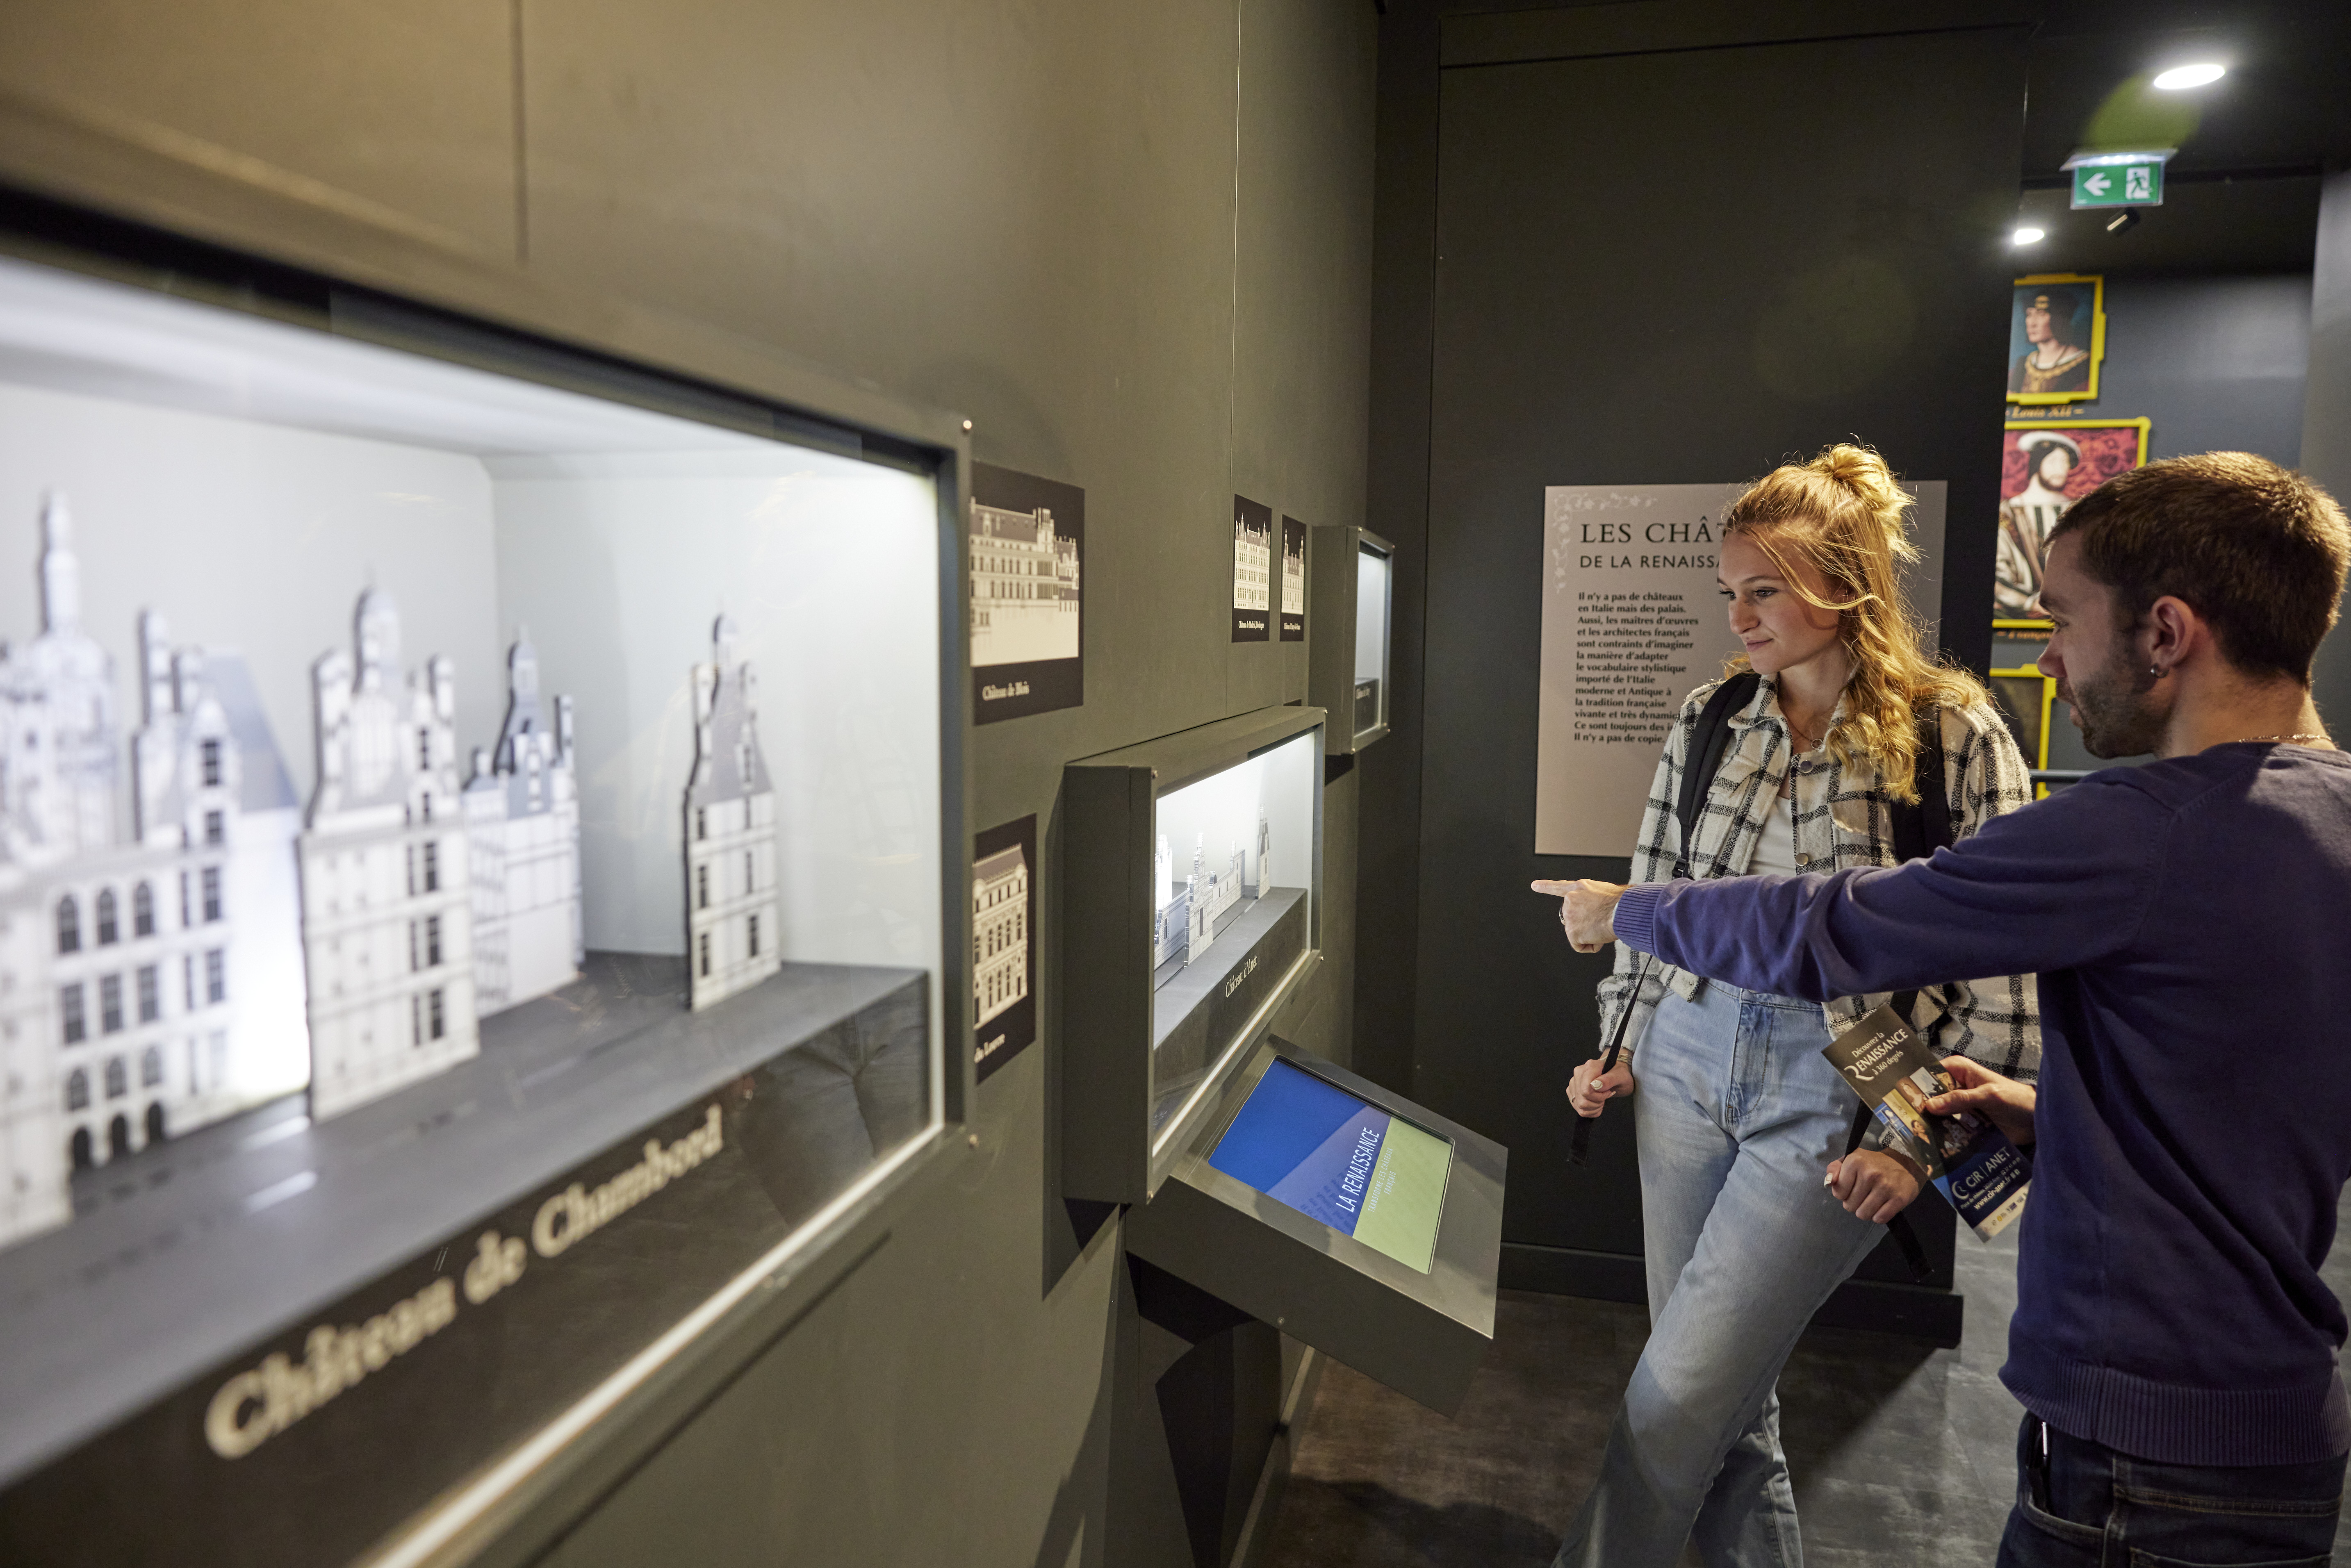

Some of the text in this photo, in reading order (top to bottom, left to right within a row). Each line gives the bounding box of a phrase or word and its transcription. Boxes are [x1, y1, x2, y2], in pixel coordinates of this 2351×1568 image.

[1581, 523, 1631, 543] LES
[1580, 555, 1720, 568] DE LA RENAISS
[1579, 592, 1585, 600] Il
[1612, 593, 1626, 603] pas
[1629, 592, 1639, 601] de
[1643, 592, 1683, 601] châteaux
[1592, 604, 1614, 612] Italie
[1617, 604, 1637, 612] mais
[1640, 604, 1654, 612] des
[1658, 604, 1686, 614] palais.
[1578, 616, 1603, 624] Aussi,
[1606, 616, 1617, 624] les
[1589, 628, 1600, 636] les
[1654, 628, 1690, 638] français
[1576, 651, 1584, 660] la
[1587, 651, 1623, 660] manière
[1576, 662, 1584, 671] le
[1641, 664, 1686, 674] stylistique
[1576, 674, 1611, 684] importé
[1613, 675, 1624, 683] de
[1628, 687, 1663, 697] Antique
[1666, 687, 1671, 696] à
[1575, 697, 1666, 708] la tradition française
[1575, 709, 1606, 717] vivante
[1611, 722, 1646, 732] toujours
[1607, 735, 1621, 744] pas
[1226, 972, 1243, 998] Château
[1852, 1036, 1879, 1058] Découvrez
[1844, 1029, 1908, 1081] RENAISSANCE
[1876, 1062, 1888, 1072] 360
[1886, 1051, 1903, 1064] degrés
[1985, 1147, 2010, 1172] ANET
[1336, 1127, 1379, 1212] LA RENAISSANCE
[1384, 1171, 1396, 1195] FRANÇAIS
[1368, 1181, 1383, 1212] TRANSFORME
[1974, 1176, 2011, 1210] www.cir-anet.fr
[204, 1103, 722, 1459] Château de Chambord
